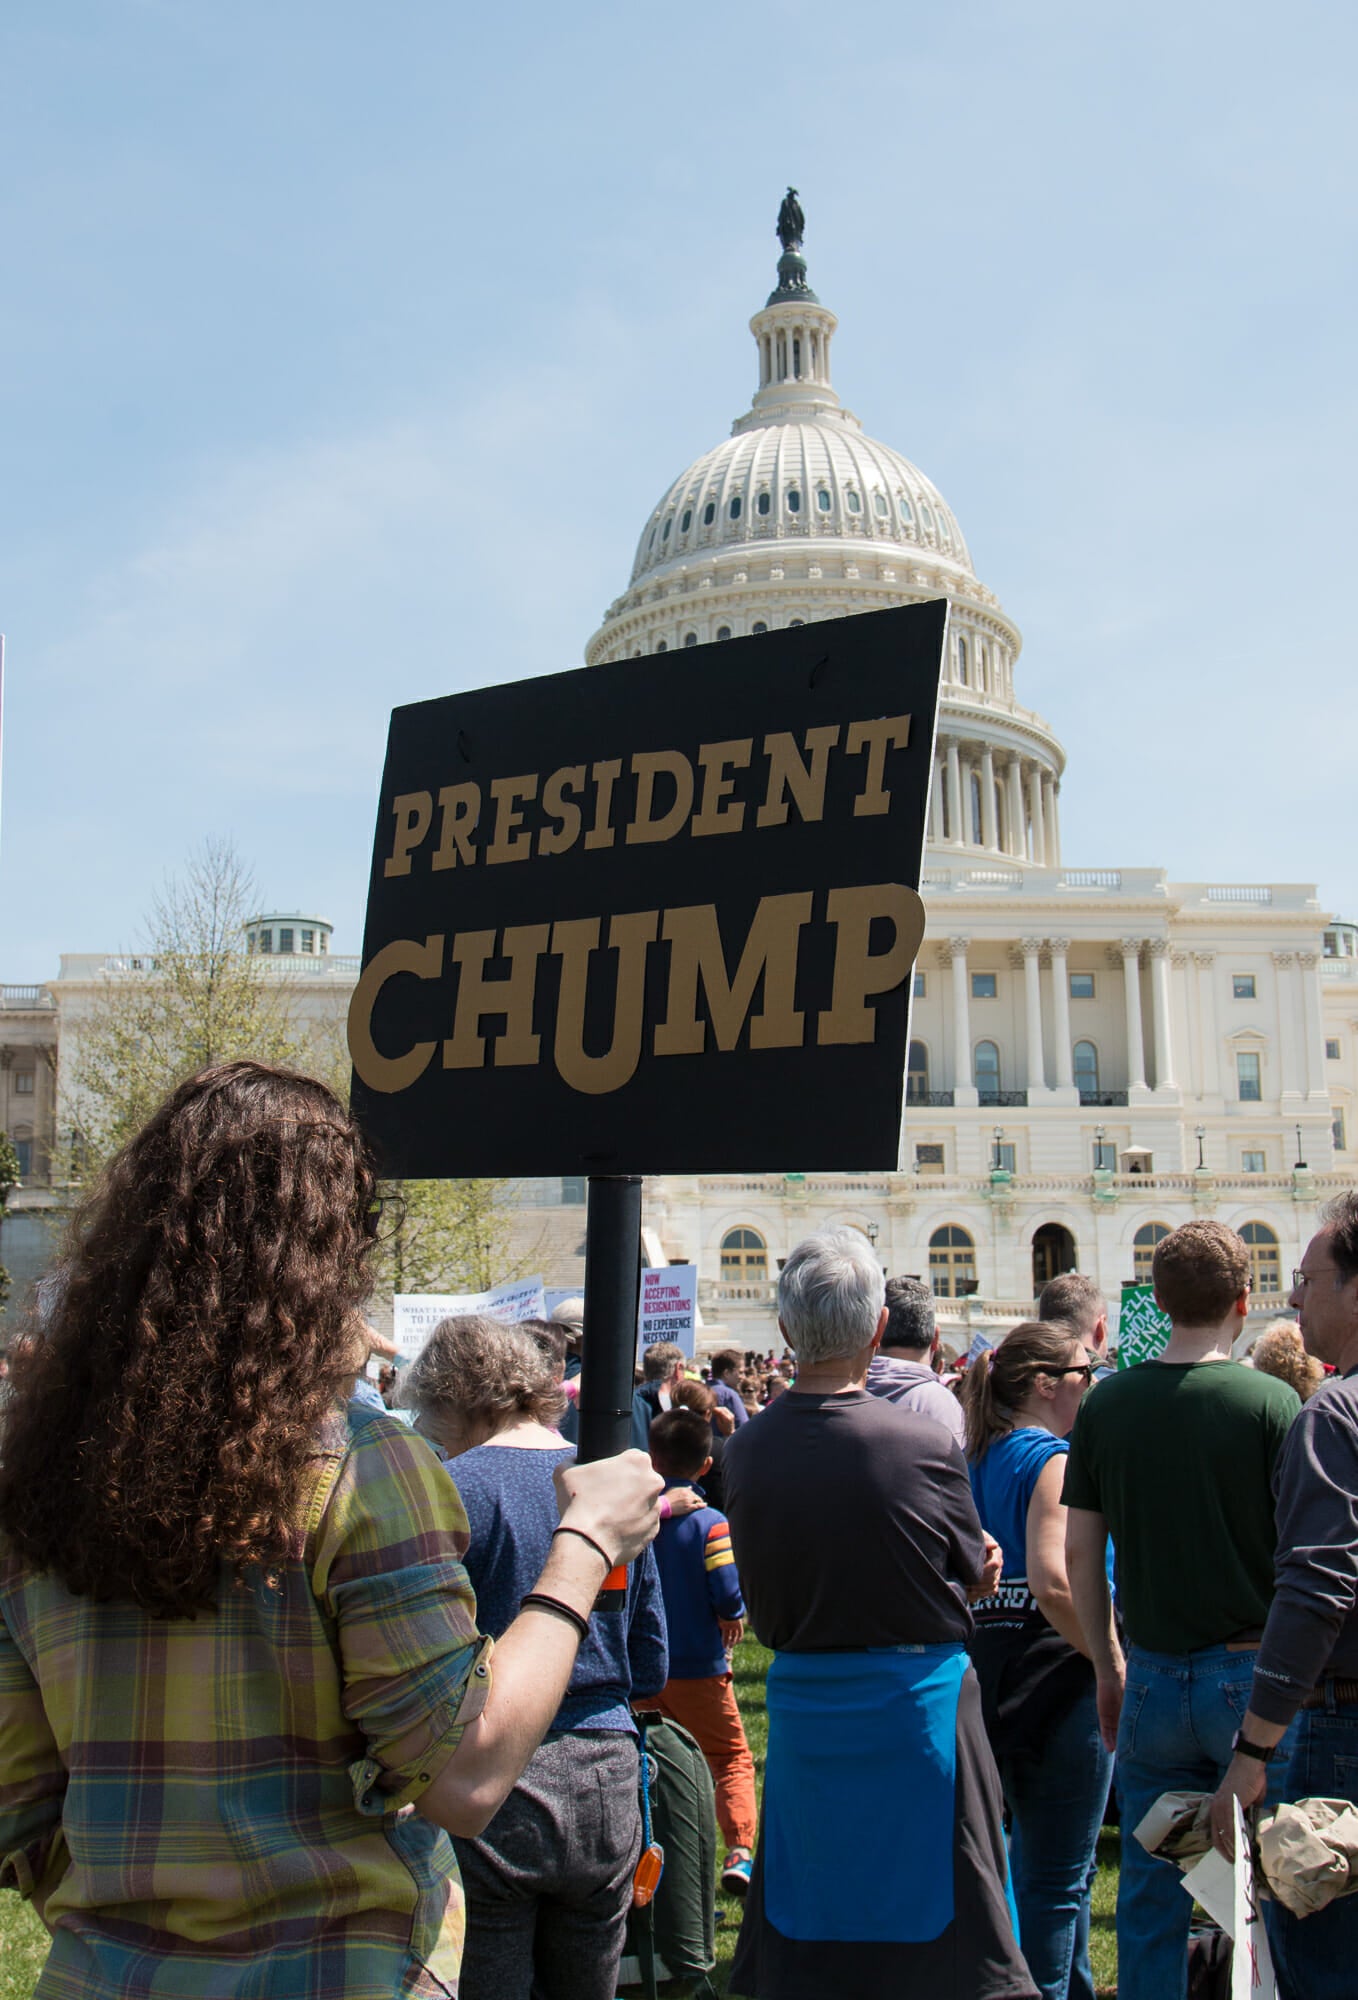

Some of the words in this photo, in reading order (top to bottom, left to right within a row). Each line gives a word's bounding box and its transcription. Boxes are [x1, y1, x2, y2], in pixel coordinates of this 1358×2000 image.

[384, 714, 911, 877] PRESIDENT
[347, 883, 926, 1094] CHUMP
[645, 1274, 660, 1285] NOW
[644, 1286, 680, 1299] ACCEPTING
[644, 1299, 691, 1313] RESIGNATIONS
[411, 1315, 423, 1324] TO
[643, 1320, 652, 1331] NO
[653, 1317, 691, 1330] EXPERIENCE
[1119, 1301, 1156, 1349] SHOW
[643, 1331, 679, 1344] NECESSARY
